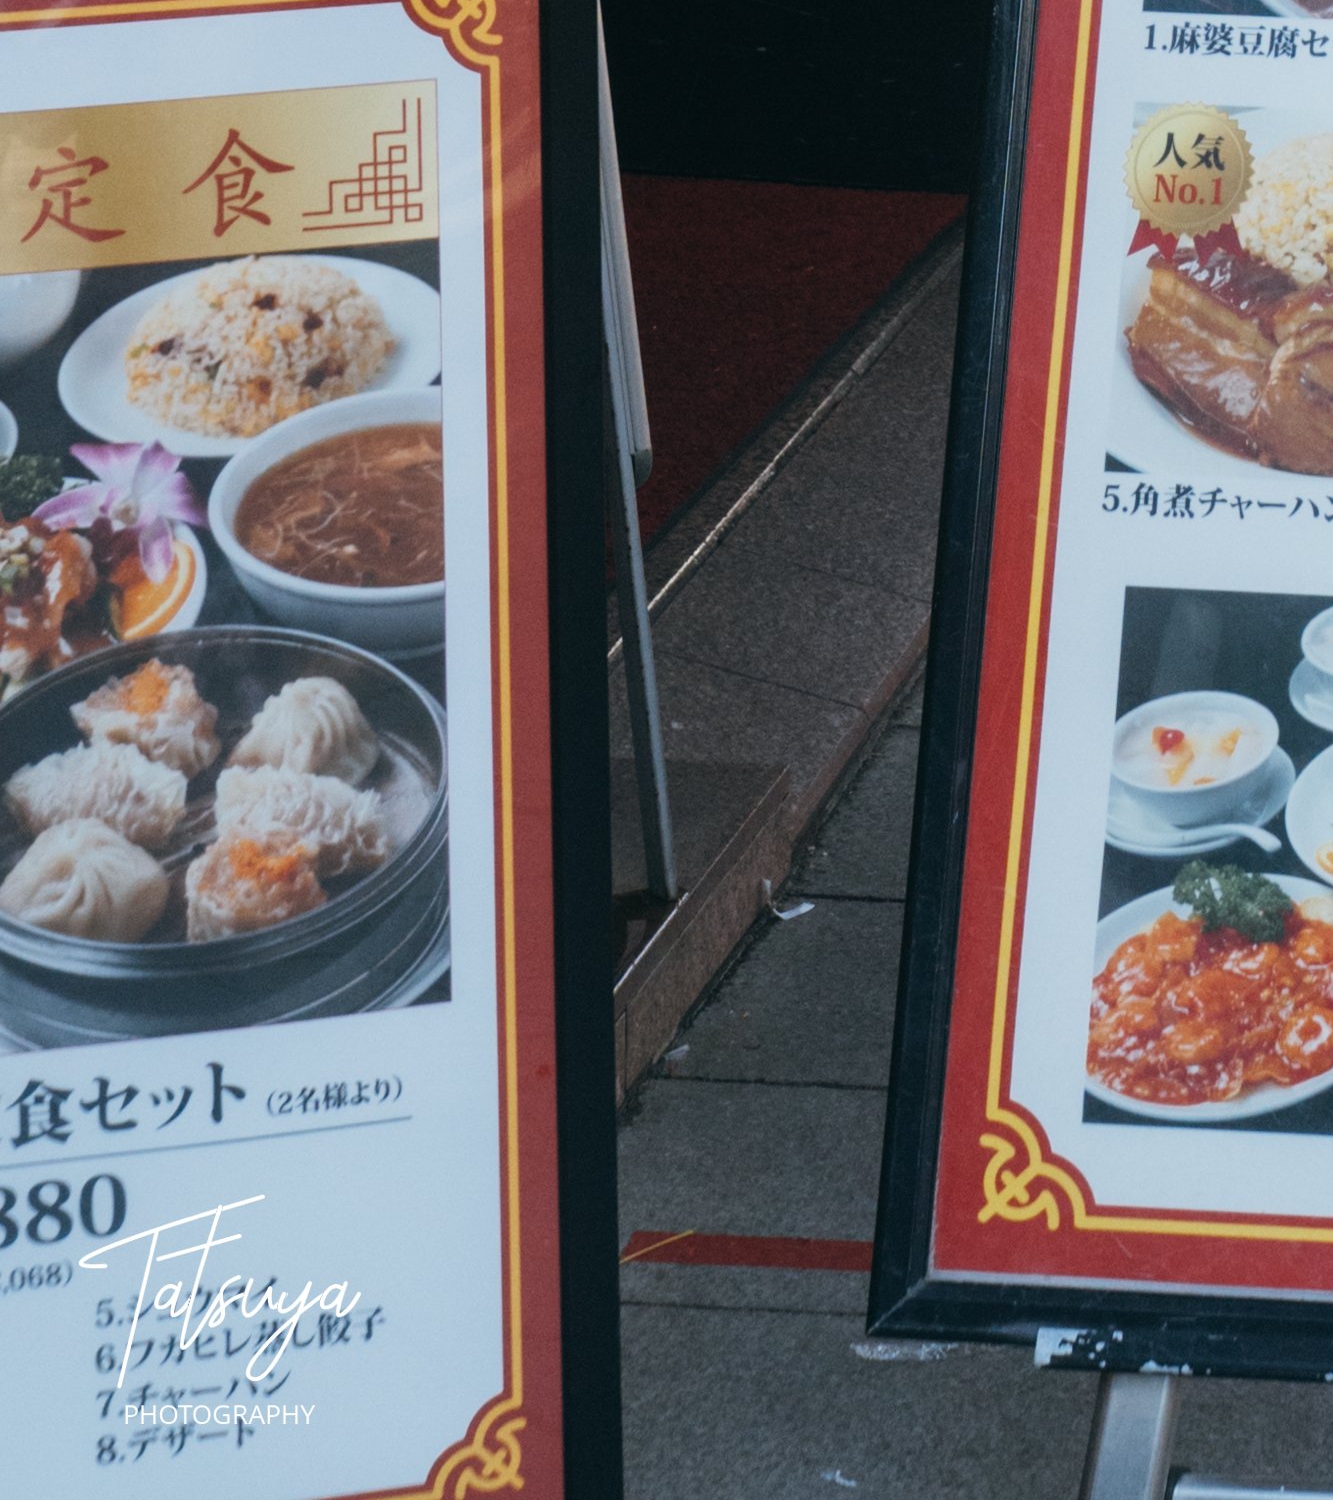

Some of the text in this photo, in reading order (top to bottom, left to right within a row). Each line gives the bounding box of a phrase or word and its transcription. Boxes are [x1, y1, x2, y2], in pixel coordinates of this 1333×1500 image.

[1153, 130, 1227, 171] 人気
[1153, 172, 1224, 208] No.1
[0, 1061, 248, 1151] 食セット
[265, 1073, 404, 1117] (2名様より)
